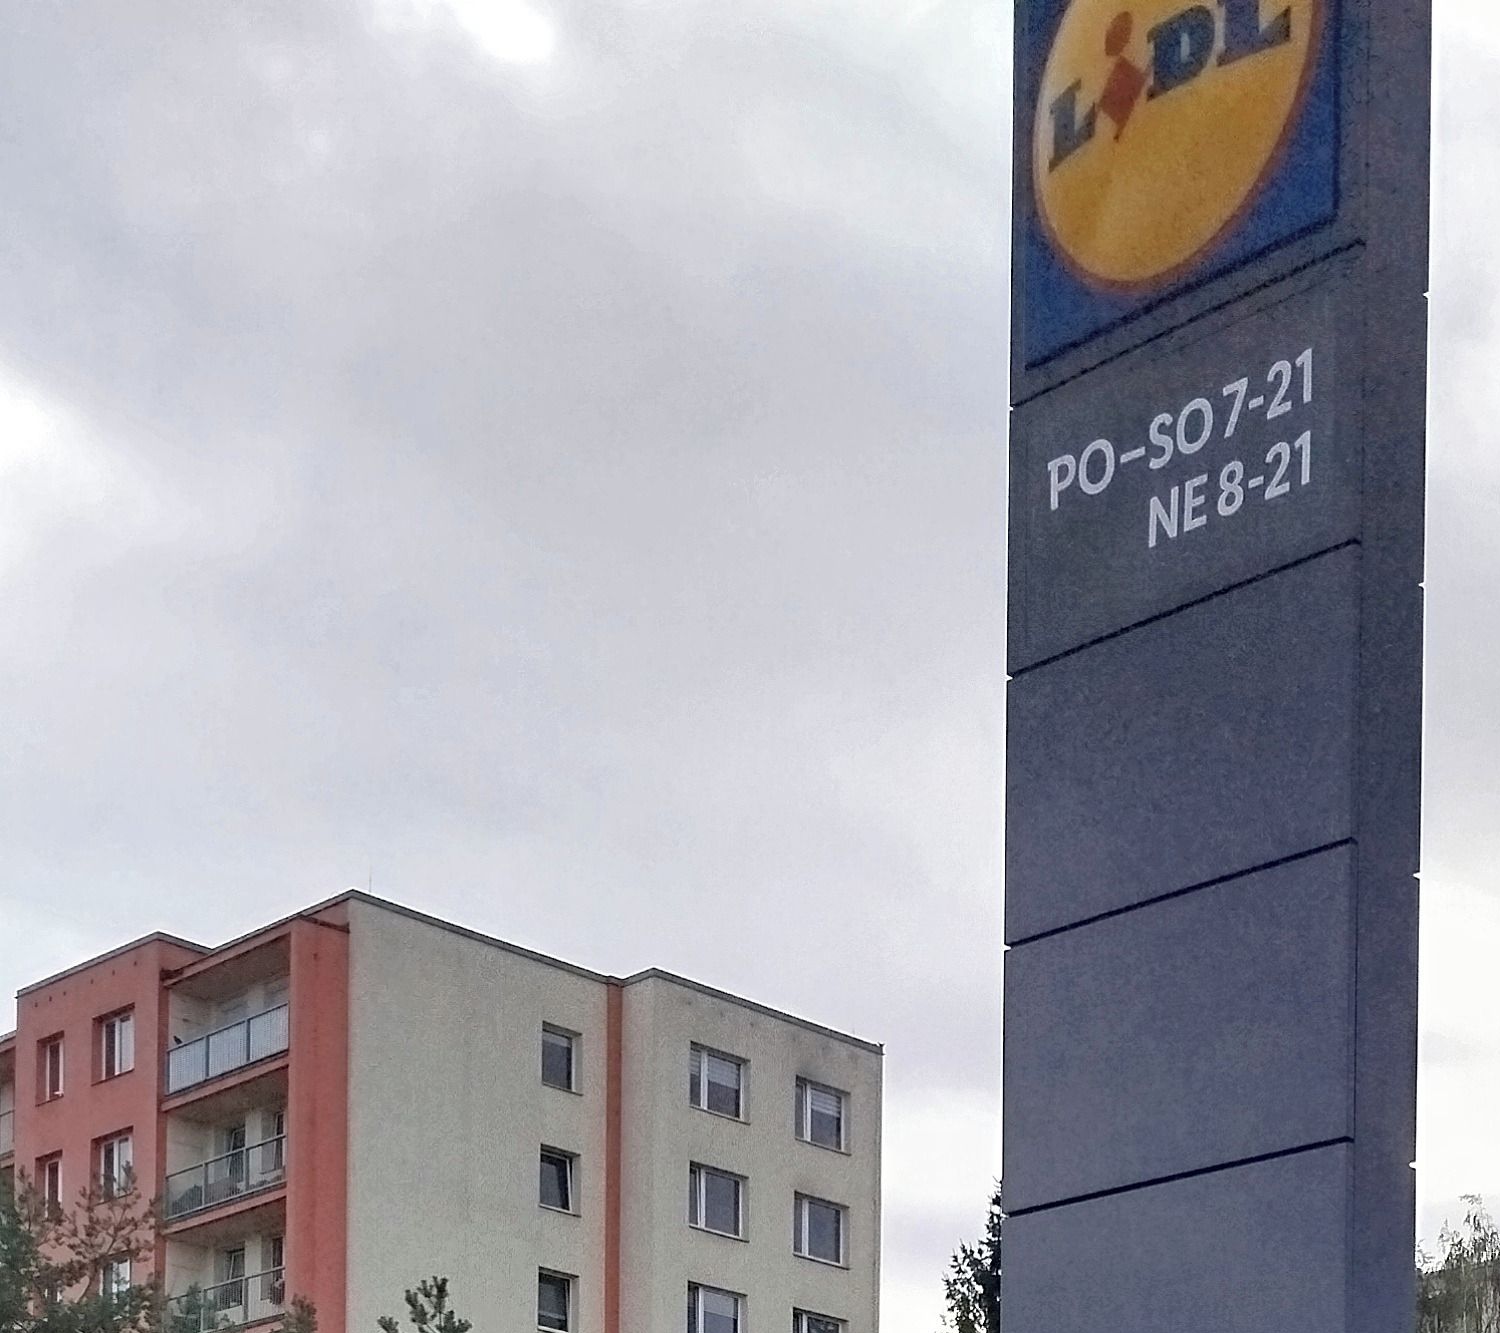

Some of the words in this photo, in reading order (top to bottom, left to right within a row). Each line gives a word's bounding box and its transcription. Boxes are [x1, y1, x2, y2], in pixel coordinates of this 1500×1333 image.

[1222, 347, 1314, 439] 7-21
[1148, 473, 1208, 549] NE
[1217, 430, 1312, 517] 8-21
